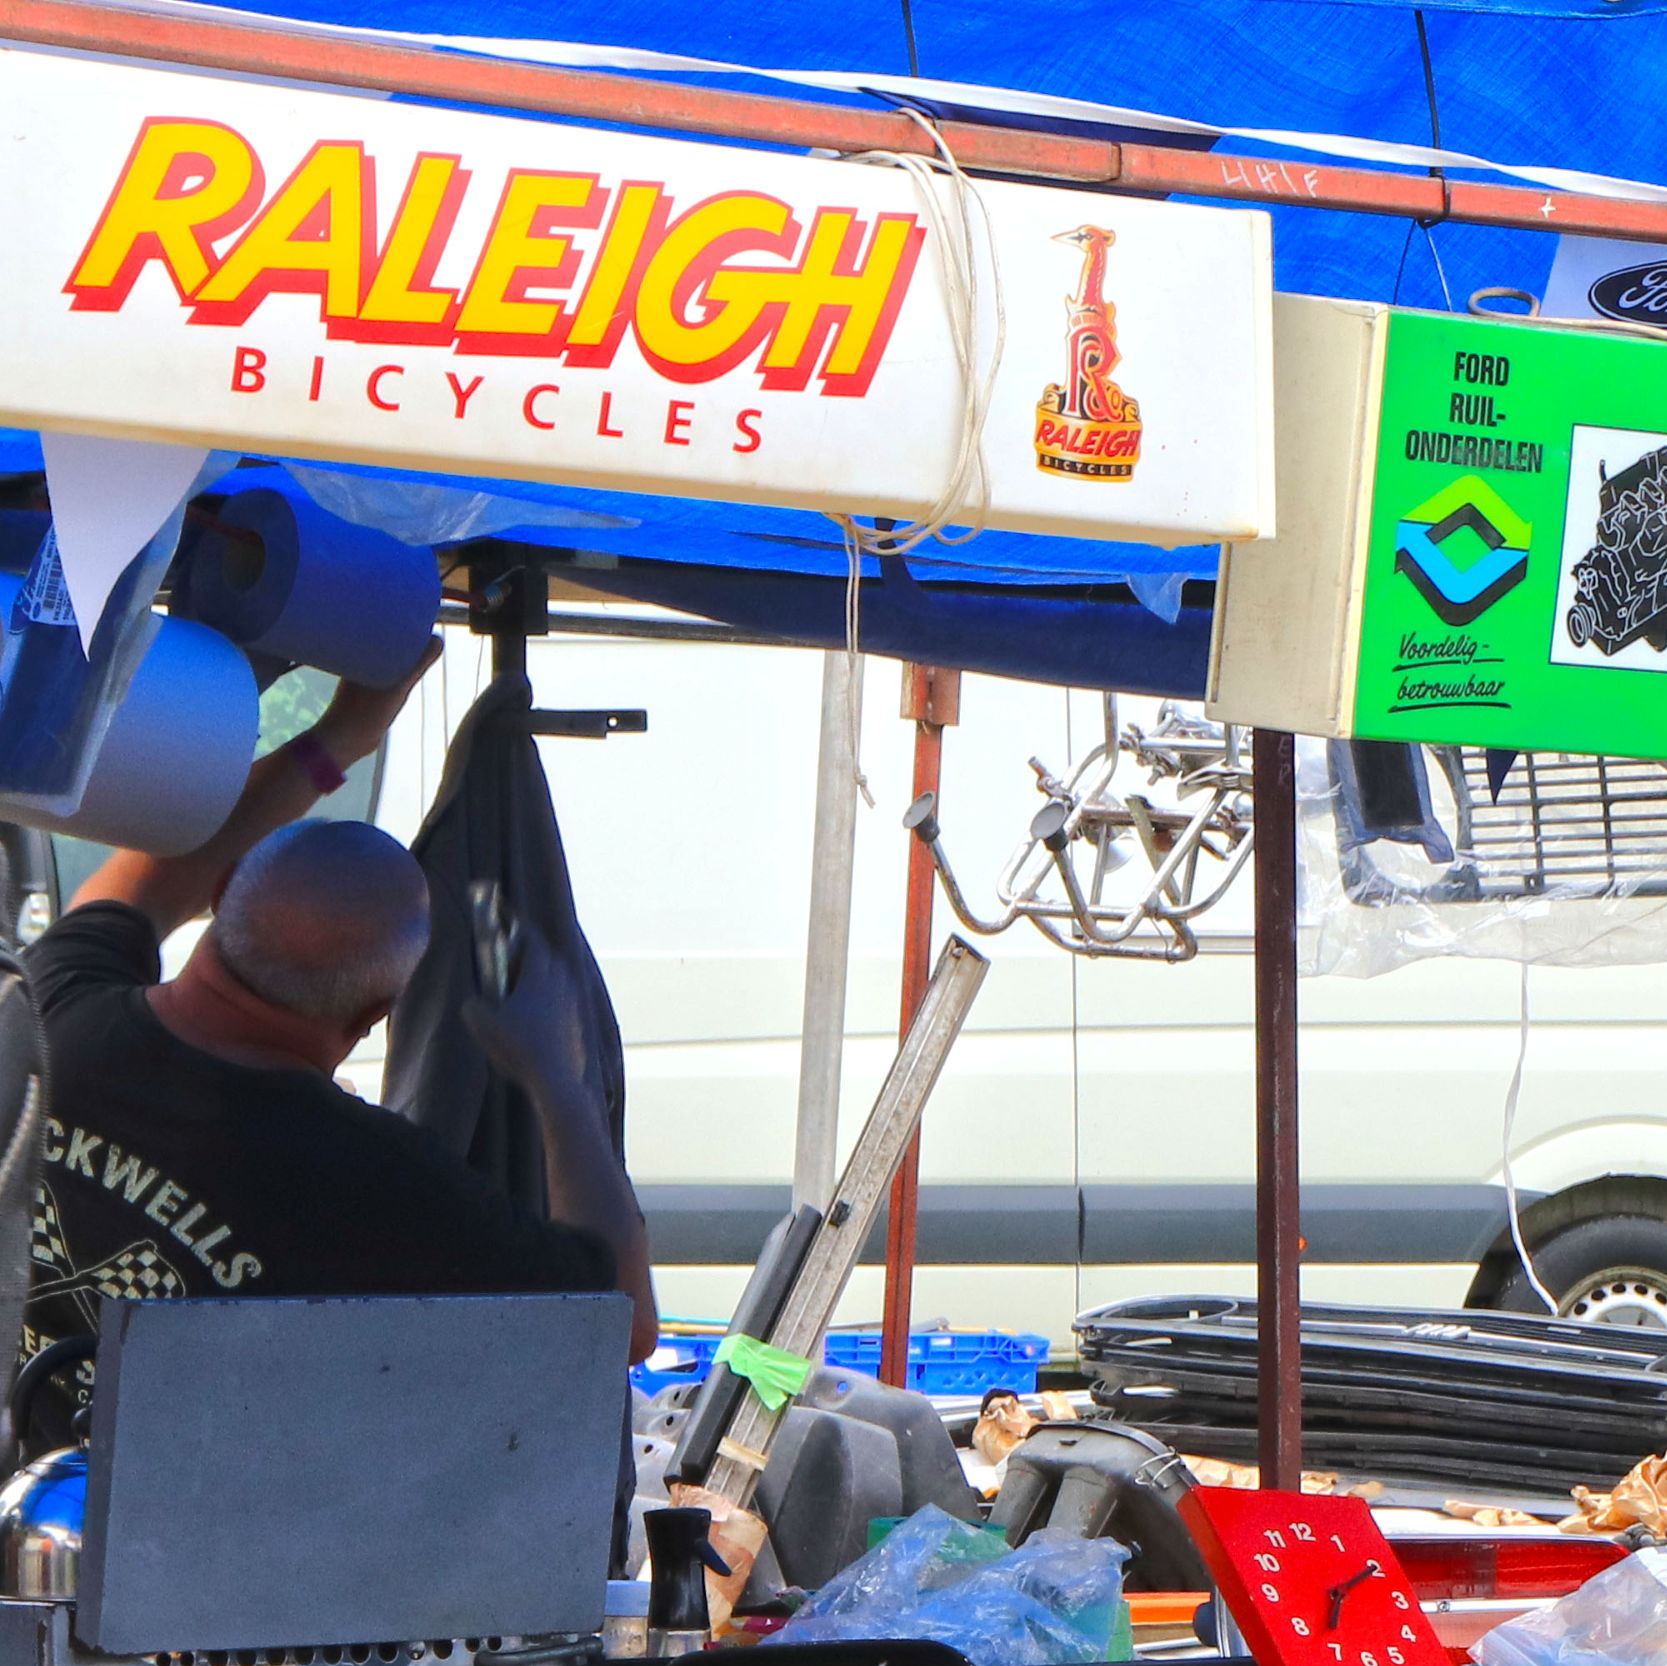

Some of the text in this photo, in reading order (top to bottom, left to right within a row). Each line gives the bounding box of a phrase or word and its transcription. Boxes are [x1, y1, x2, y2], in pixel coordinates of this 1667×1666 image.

[63, 115, 926, 397] RALEIGH
[1454, 350, 1510, 387] FORD
[231, 345, 763, 454] BICYCLES
[1450, 392, 1506, 428] RUIL-
[1036, 419, 1141, 458] RALEIGH
[1404, 427, 1543, 474] ONDERDELEN
[1043, 454, 1131, 476] BICYCLES
[1397, 674, 1506, 701] betrouwbaar
[42, 1116, 264, 1289] CKWELLS
[1263, 1529, 1286, 1549] 11
[1288, 1522, 1316, 1541] 12
[1330, 1534, 1345, 1553] 1
[1253, 1553, 1281, 1572] 10
[1366, 1559, 1386, 1578] 2
[1261, 1583, 1280, 1602] 9
[1391, 1591, 1410, 1610] 3
[1291, 1617, 1310, 1636] 8
[1400, 1624, 1417, 1643] 4
[1327, 1643, 1342, 1661] 7
[1386, 1646, 1405, 1665] 5
